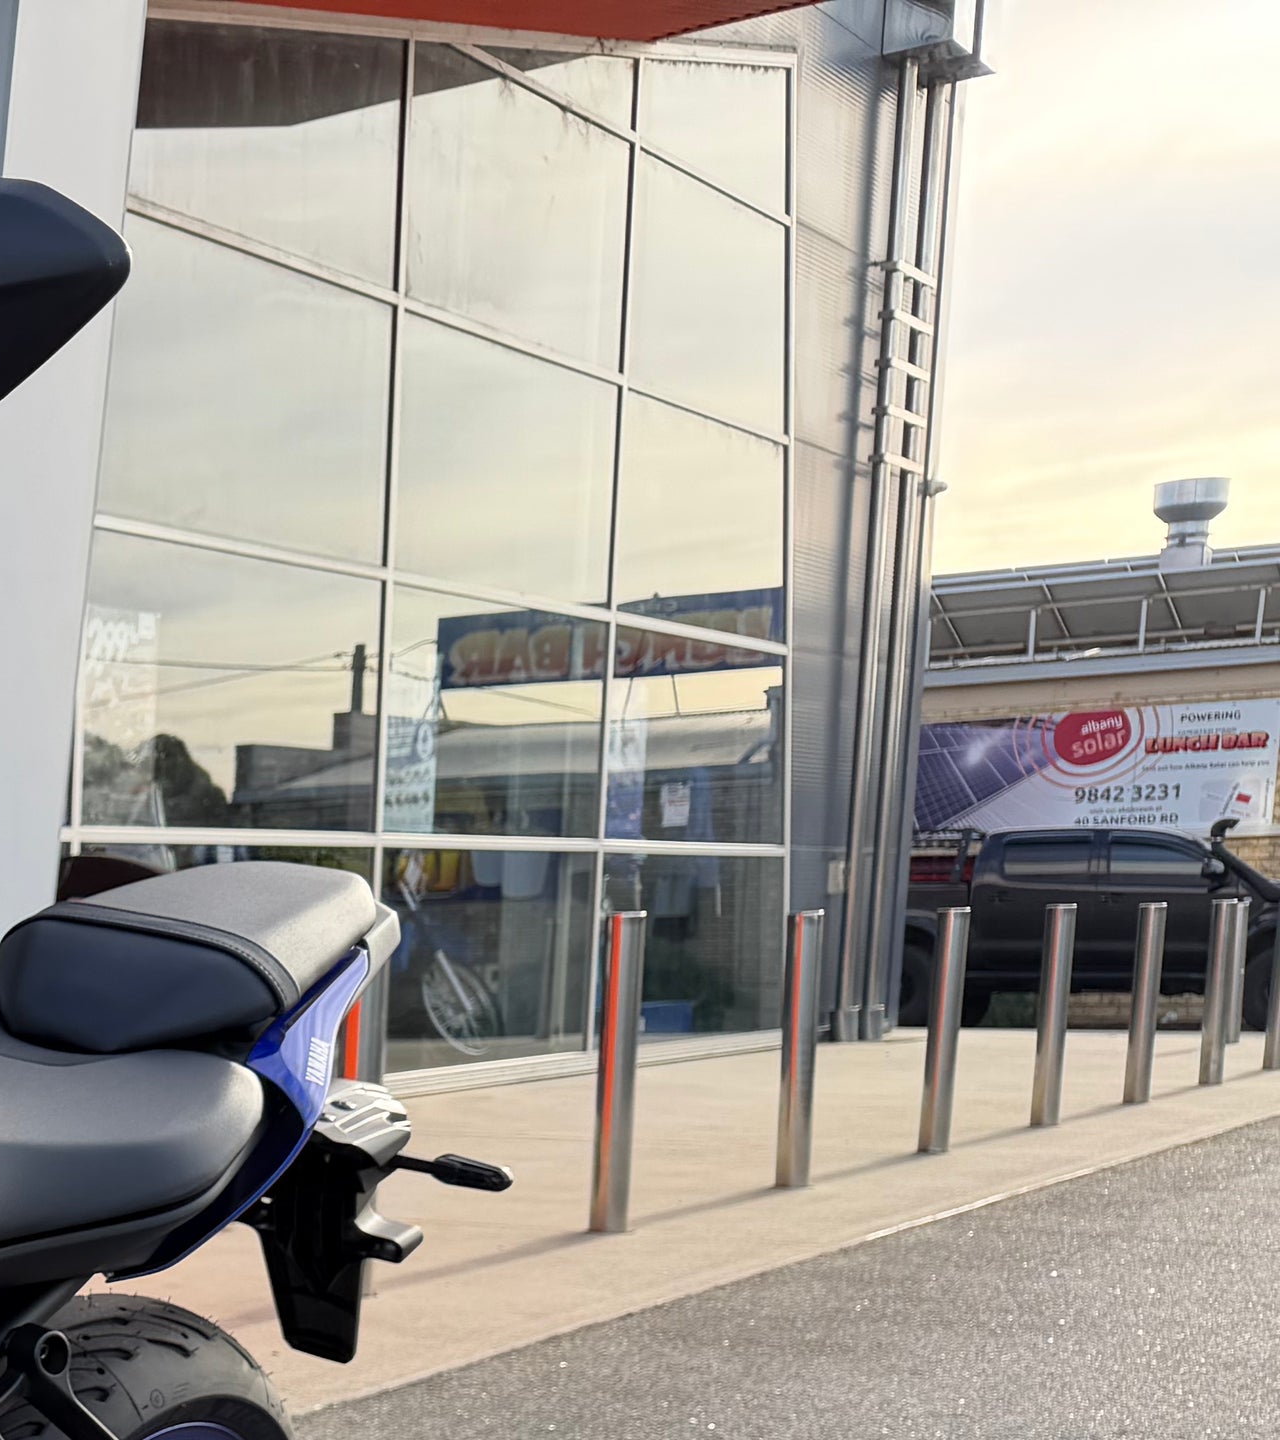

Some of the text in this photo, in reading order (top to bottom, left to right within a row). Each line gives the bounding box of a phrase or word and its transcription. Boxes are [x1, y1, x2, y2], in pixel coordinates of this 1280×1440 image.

[1081, 714, 1123, 736] albany
[1180, 710, 1241, 723] POWERING
[1072, 729, 1126, 758] solar
[1145, 734, 1220, 755] LUNCH
[1221, 731, 1270, 750] BAR
[1074, 783, 1181, 804] 9842 3231
[1092, 813, 1156, 825] SANFORD
[1160, 812, 1179, 824] RD
[305, 1036, 331, 1087] YAMAHA
